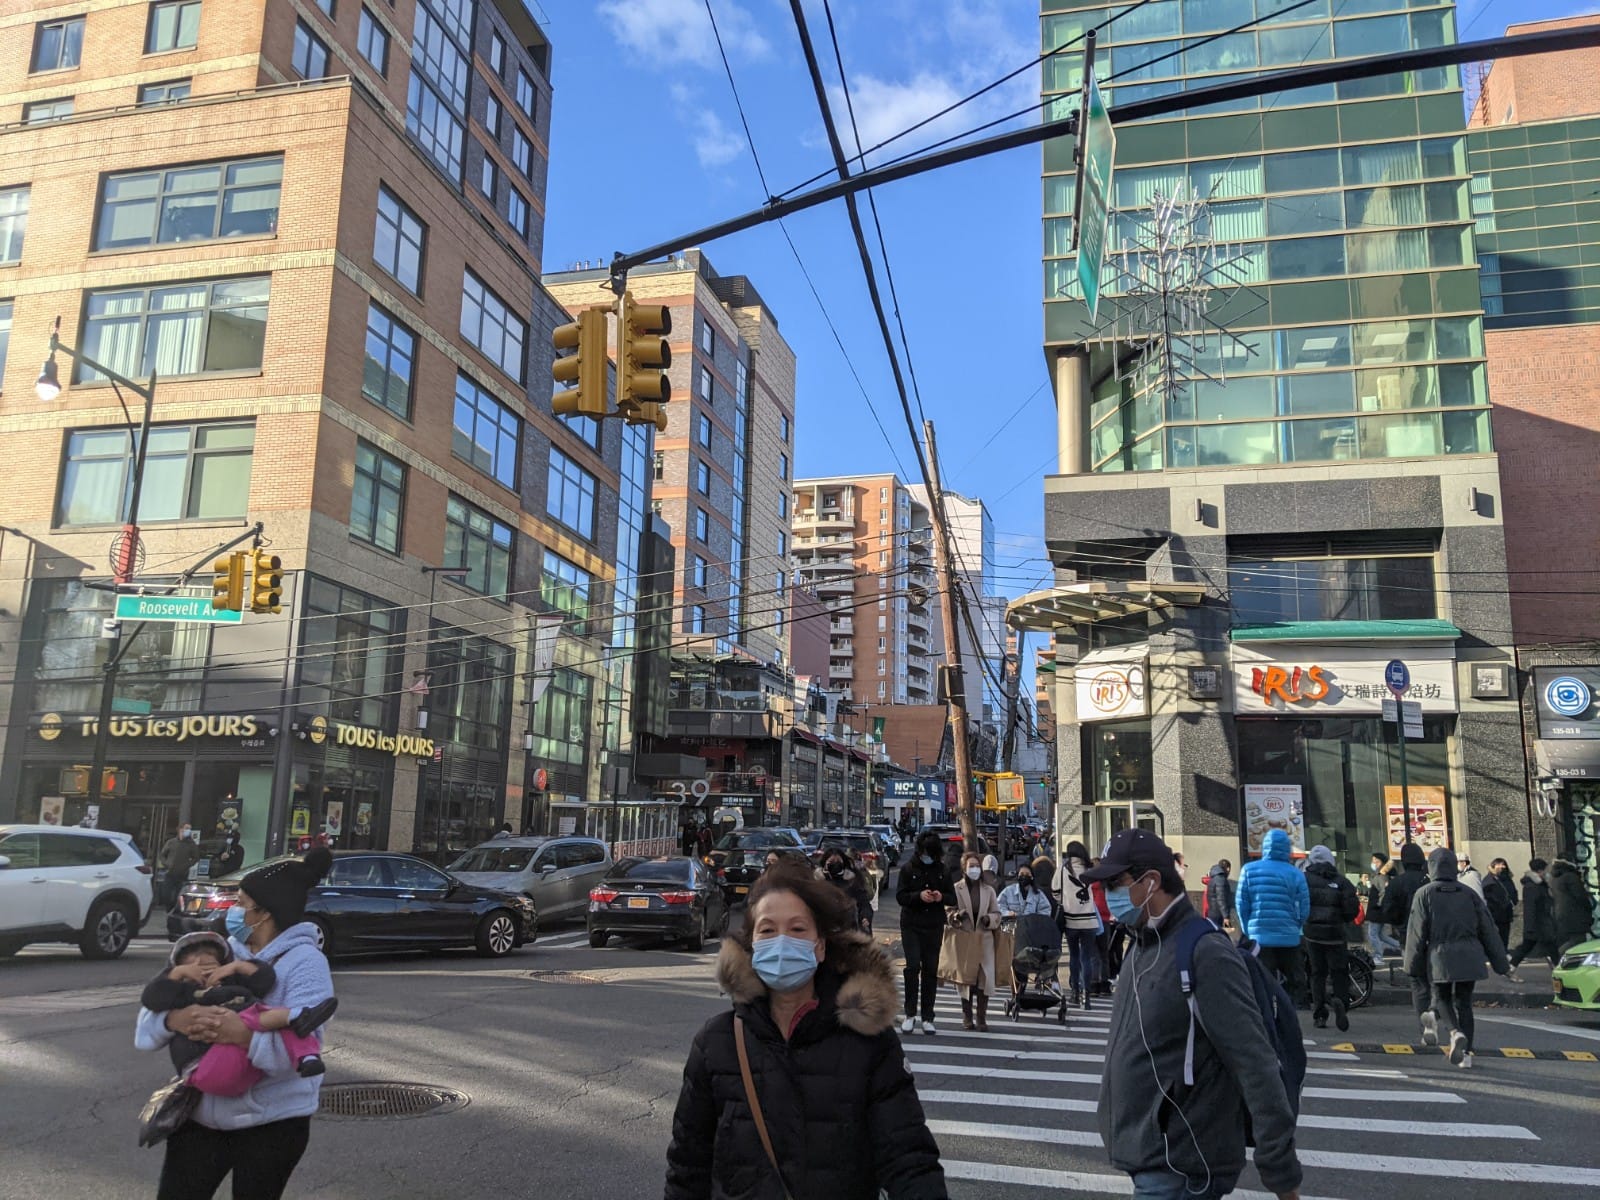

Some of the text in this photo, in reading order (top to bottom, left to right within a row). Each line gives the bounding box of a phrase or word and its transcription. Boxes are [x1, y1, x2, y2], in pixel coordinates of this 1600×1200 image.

[1090, 153, 1104, 199] St
[139, 601, 198, 616] Roosevelt
[1096, 683, 1124, 706] IRIS
[1251, 664, 1329, 707] IRIS
[1340, 683, 1441, 699] 艾瑞詩焙坊
[145, 715, 177, 737] les
[176, 714, 257, 742] JOURS
[335, 722, 434, 757] TOUS les JOURS
